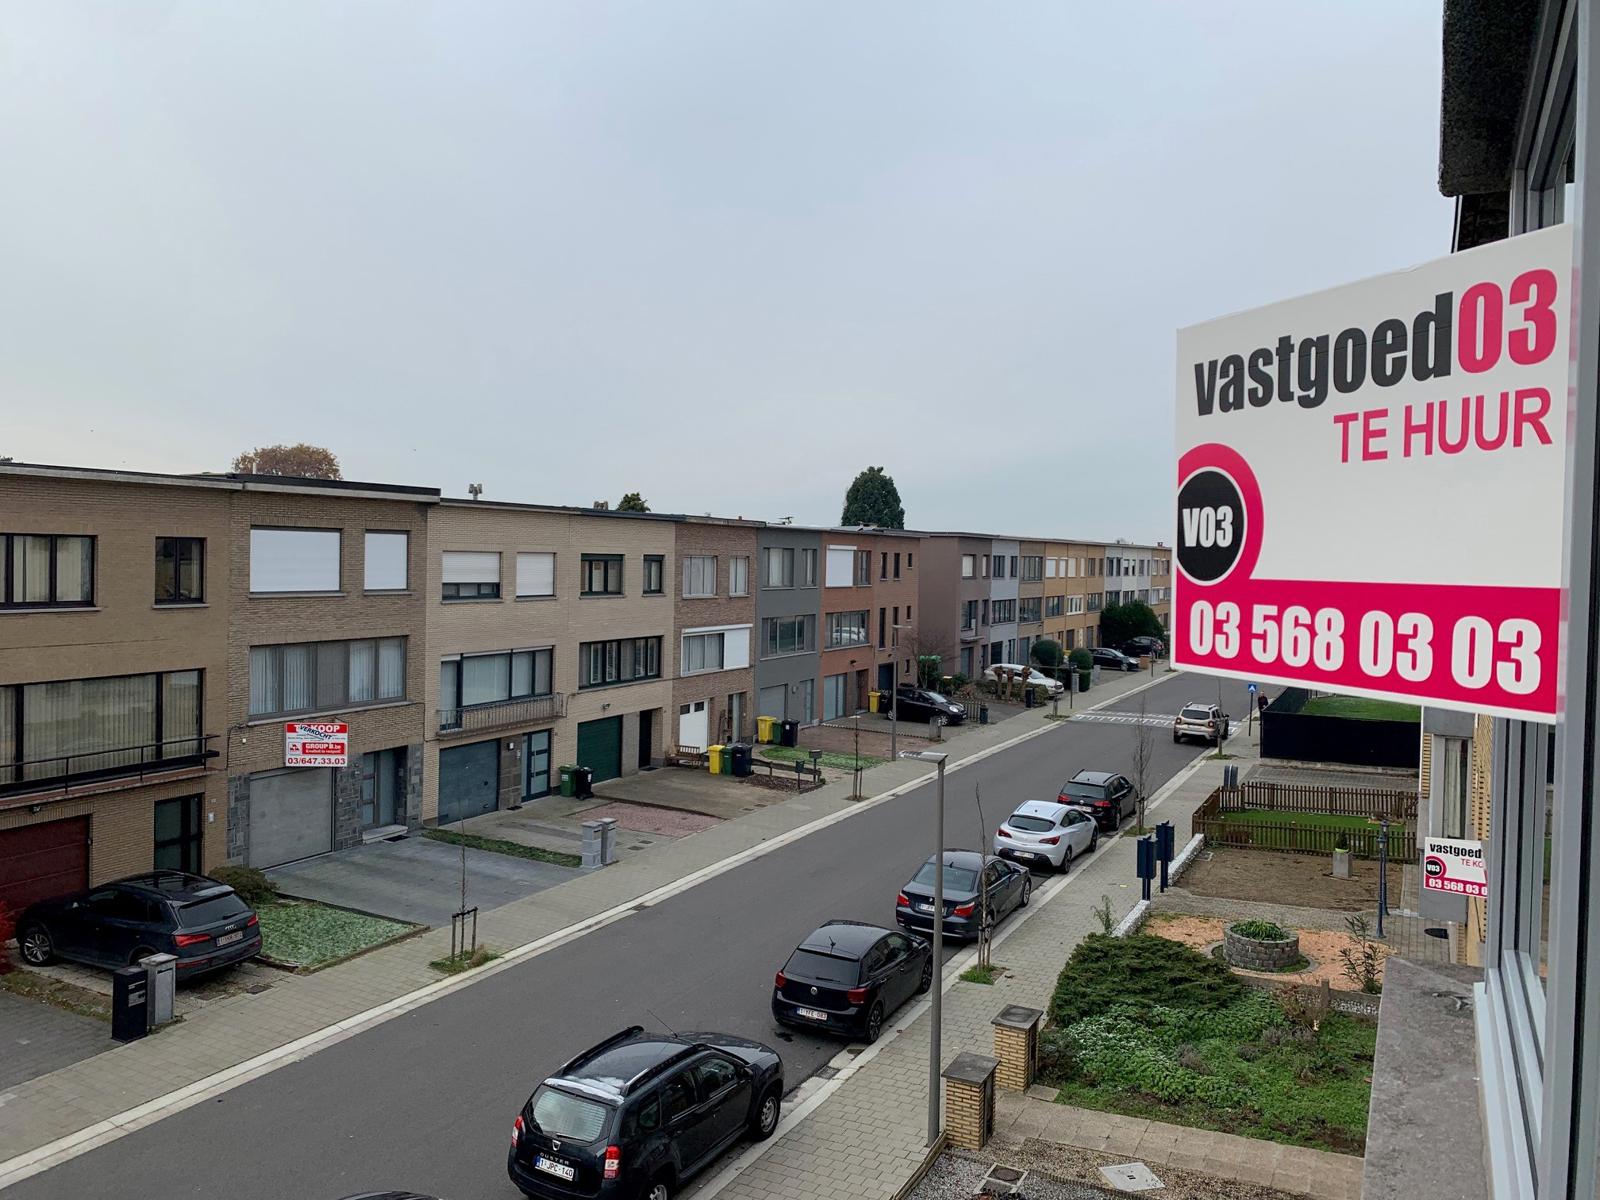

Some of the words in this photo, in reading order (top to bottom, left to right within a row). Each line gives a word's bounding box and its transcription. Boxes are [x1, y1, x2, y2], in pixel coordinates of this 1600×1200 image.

[1194, 268, 1557, 416] vastgoed03
[1333, 408, 1389, 463] TE
[1402, 388, 1553, 458] HUUR
[1183, 505, 1234, 548] V03
[1189, 600, 1241, 659] 03
[1251, 604, 1346, 672] 568
[1359, 610, 1434, 683] 03
[1451, 615, 1544, 695] 03
[1429, 879, 1442, 888] 03
[1444, 881, 1464, 892] 568
[1465, 883, 1479, 894] 03
[1461, 858, 1471, 866] TE
